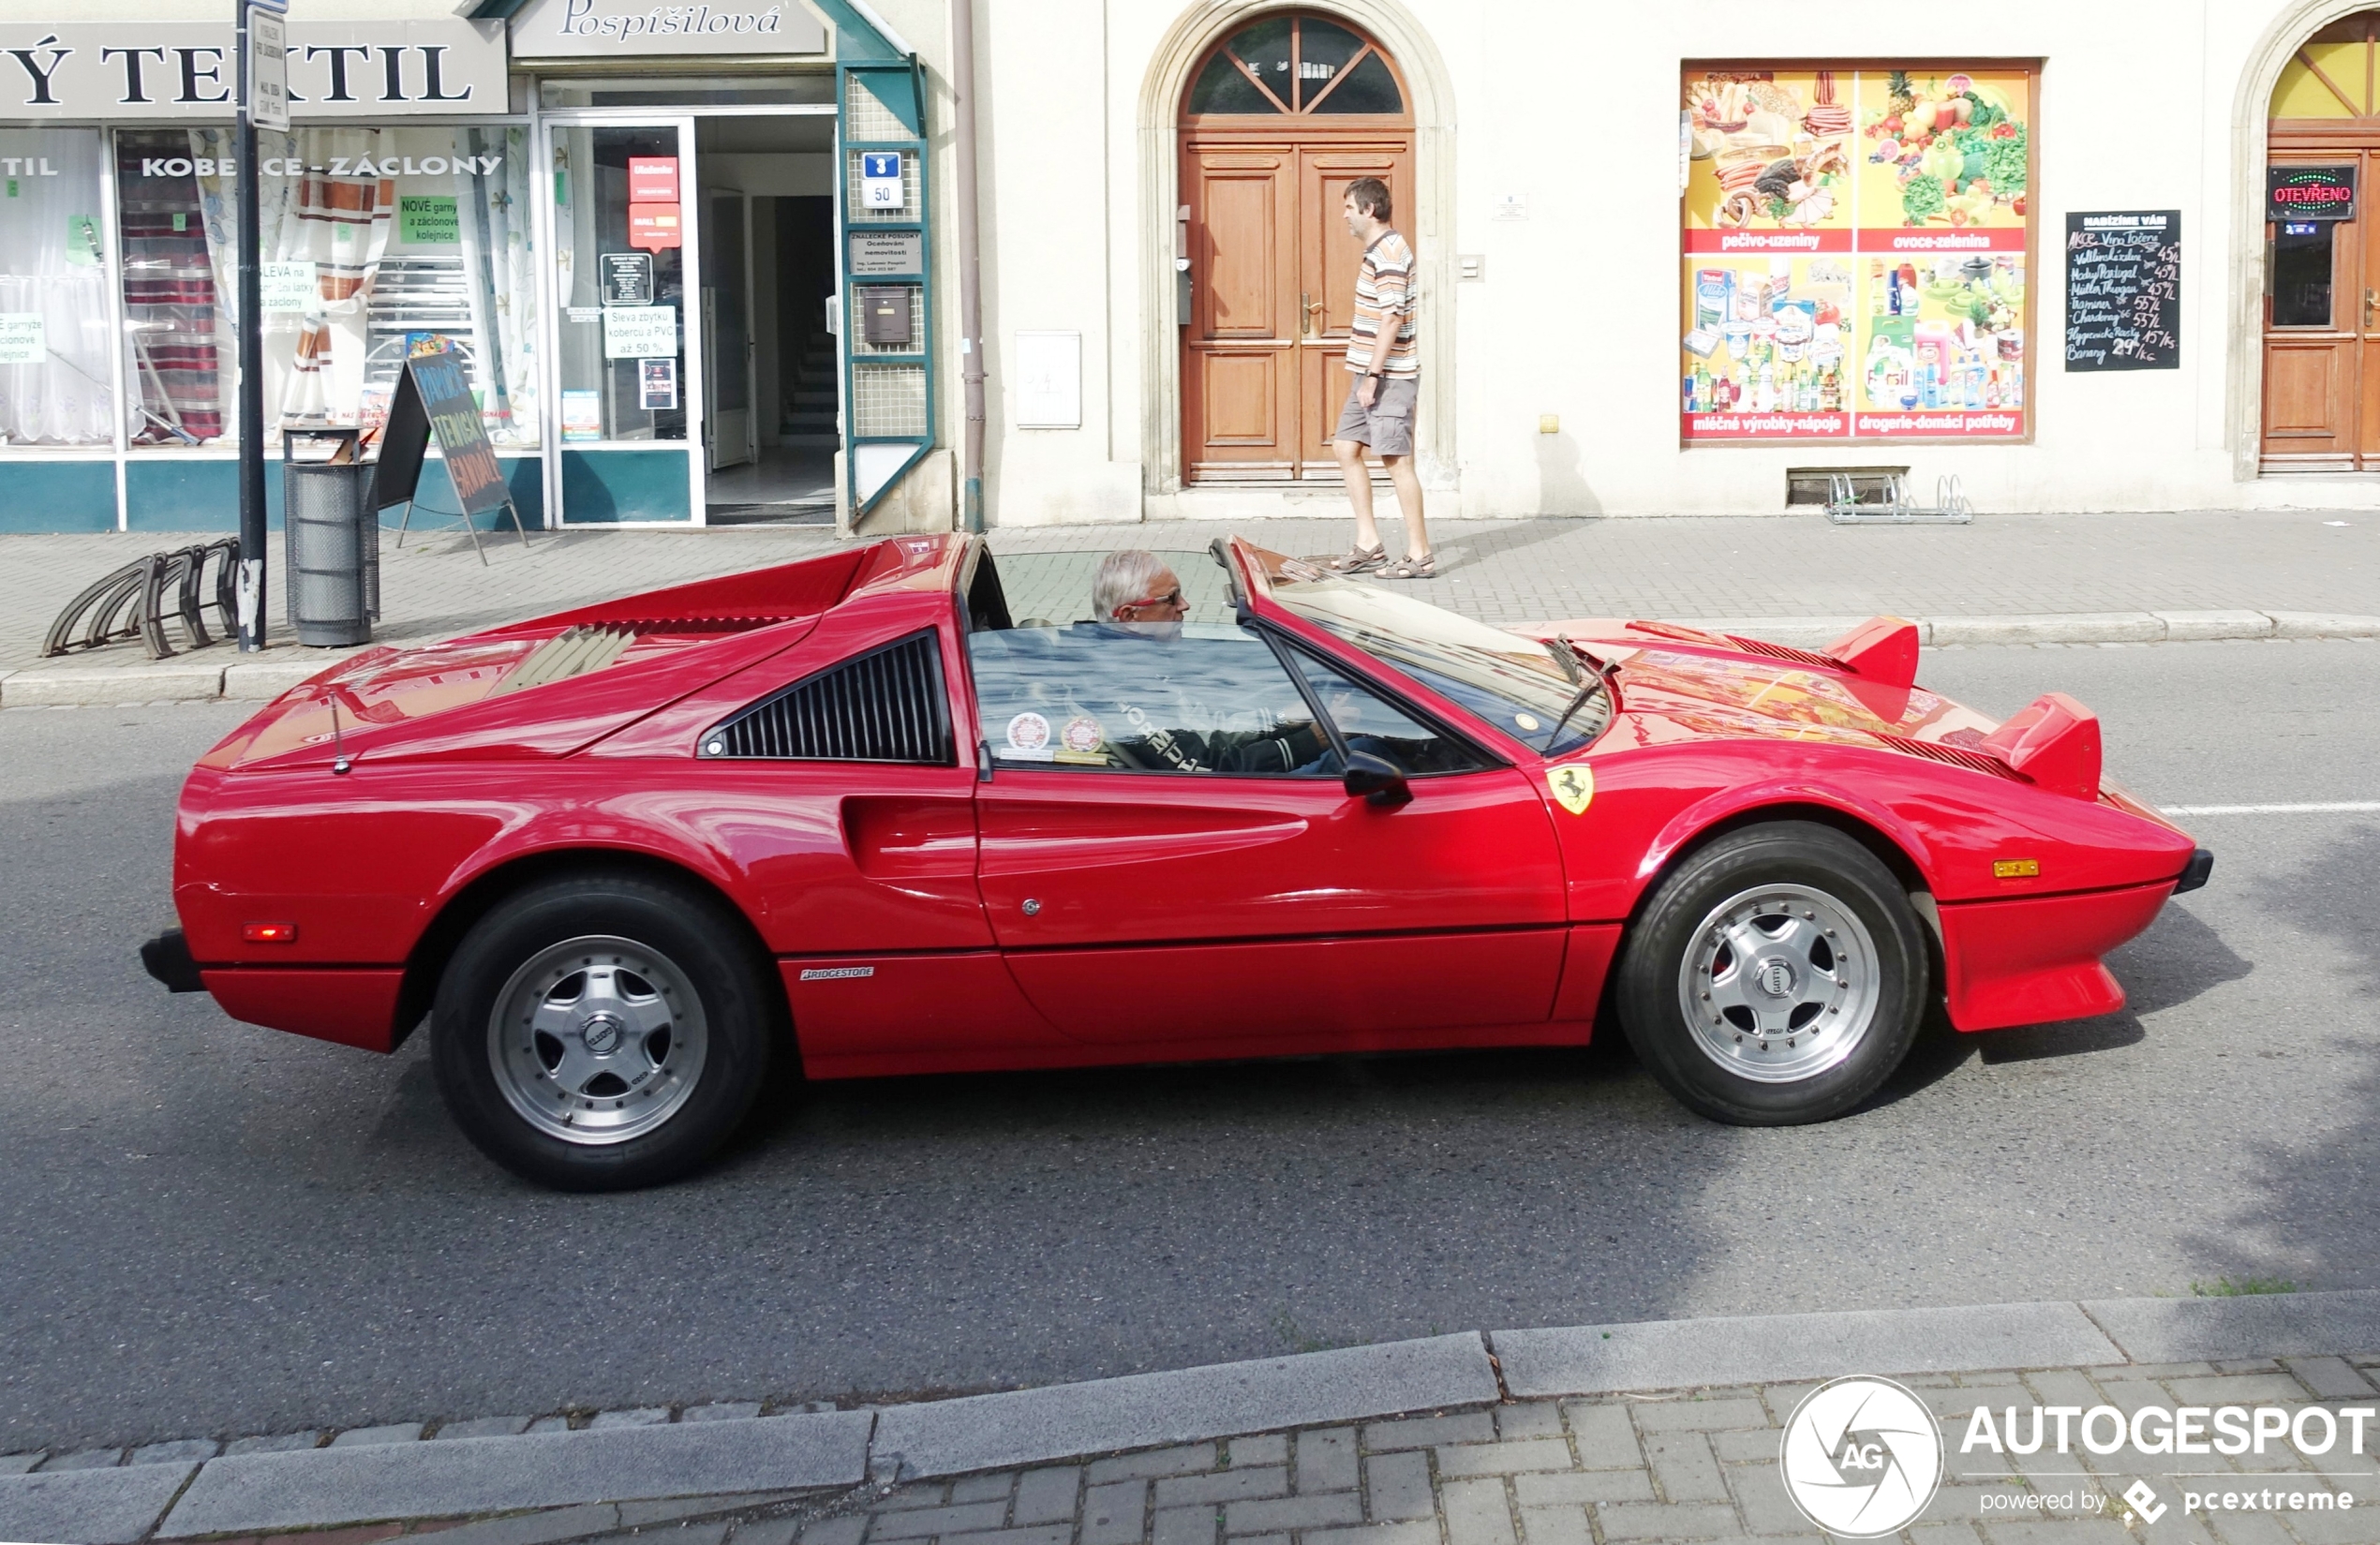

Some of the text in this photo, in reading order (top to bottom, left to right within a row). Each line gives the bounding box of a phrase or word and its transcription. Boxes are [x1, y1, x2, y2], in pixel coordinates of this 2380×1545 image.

[558, 0, 781, 42] Pospíšilová
[876, 157, 886, 174] 3
[875, 187, 890, 201] 50
[2274, 183, 2351, 202] OTEVŘENO
[402, 198, 431, 212] NOVÉ
[417, 216, 459, 226] záclonové
[2083, 214, 2167, 227] NABÍZÍME VÁM
[416, 230, 454, 242] kolejnice
[1721, 233, 1821, 250] pečivo-uzeniny
[1893, 234, 1991, 249] ovoce-zelenina
[293, 269, 305, 277] na
[268, 297, 303, 308] záclony
[612, 311, 668, 323] Sleva zbytků
[608, 327, 644, 337] koberců
[654, 325, 674, 335] PVC
[619, 343, 663, 353] až 50 %
[1692, 415, 1842, 434] mléčné výrobky-nápoje
[1858, 414, 2016, 433] drogerie-domácí potřeby
[802, 967, 873, 979] BRIDGESTONE
